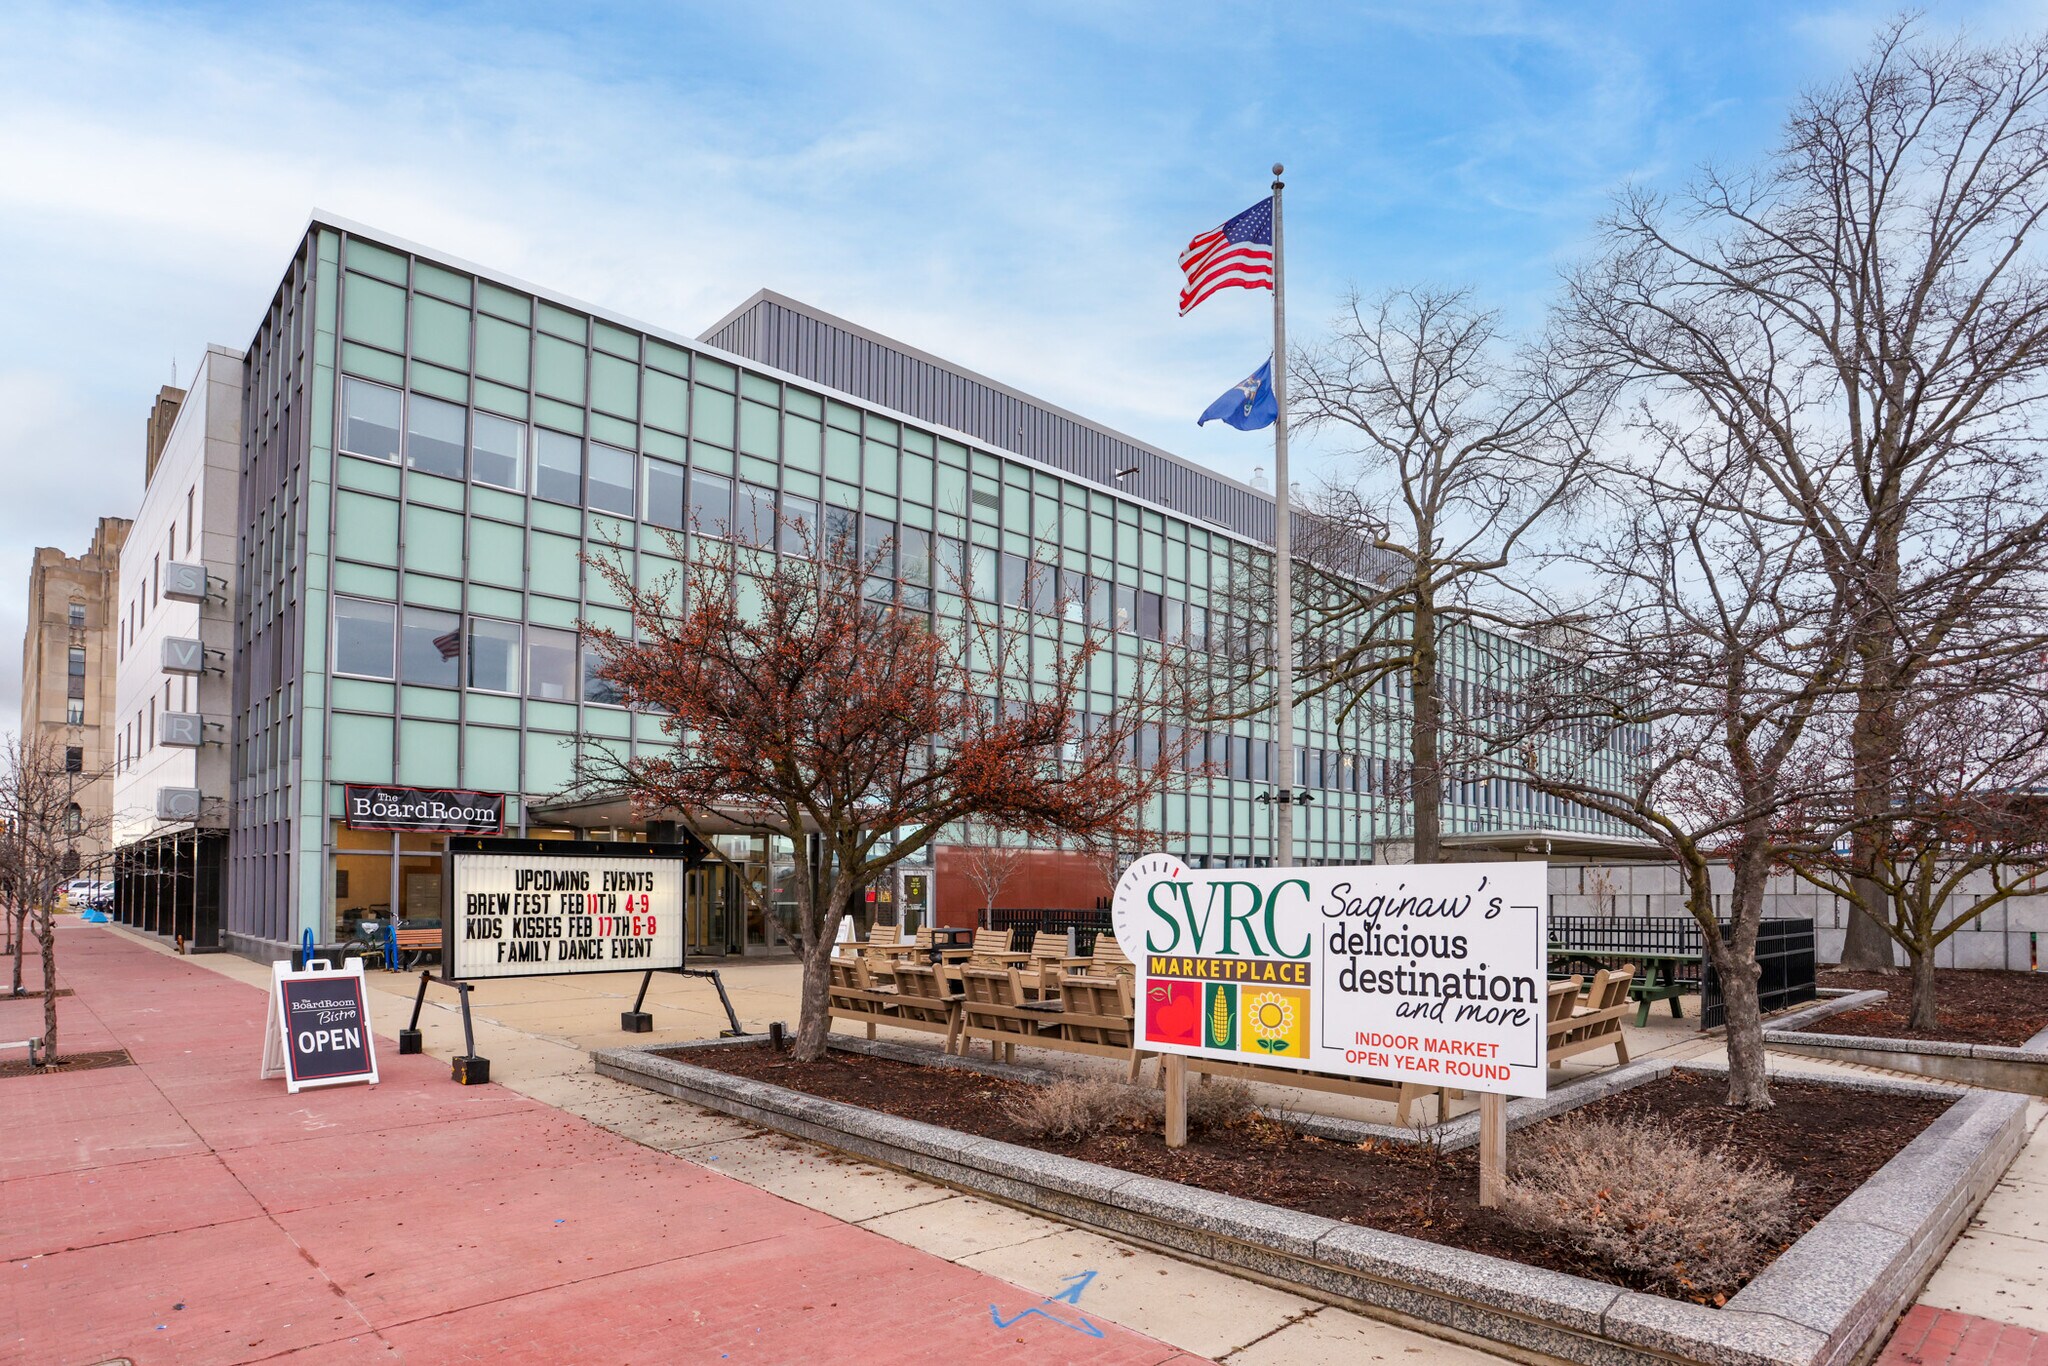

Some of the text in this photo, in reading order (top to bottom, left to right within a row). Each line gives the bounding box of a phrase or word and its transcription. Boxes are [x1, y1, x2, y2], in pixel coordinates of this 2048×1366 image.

[353, 797, 496, 822] BoardRoom
[377, 792, 398, 802] The
[515, 869, 653, 892] UPCOMING EVENTS
[466, 893, 649, 916] BREW FEST FEB 11TH 4-9
[1321, 876, 1503, 932] Saginaw's
[466, 915, 656, 940] KIDS KISSES FEB 17TH 6-8
[1146, 879, 1311, 959] SVRC
[497, 938, 653, 963] FAMILY DANCE EVENT
[1329, 921, 1468, 959] delicious
[1151, 957, 1305, 983] MARKETPLACE
[1339, 956, 1538, 1004] destination
[292, 999, 355, 1010] BoardRoom
[317, 1010, 356, 1025] Bistro
[1395, 996, 1530, 1027] and more
[298, 1027, 360, 1054] OPEN
[1355, 1031, 1499, 1058] INDOOR MARKET
[1345, 1050, 1511, 1081] OPEN YEAR ROUND
